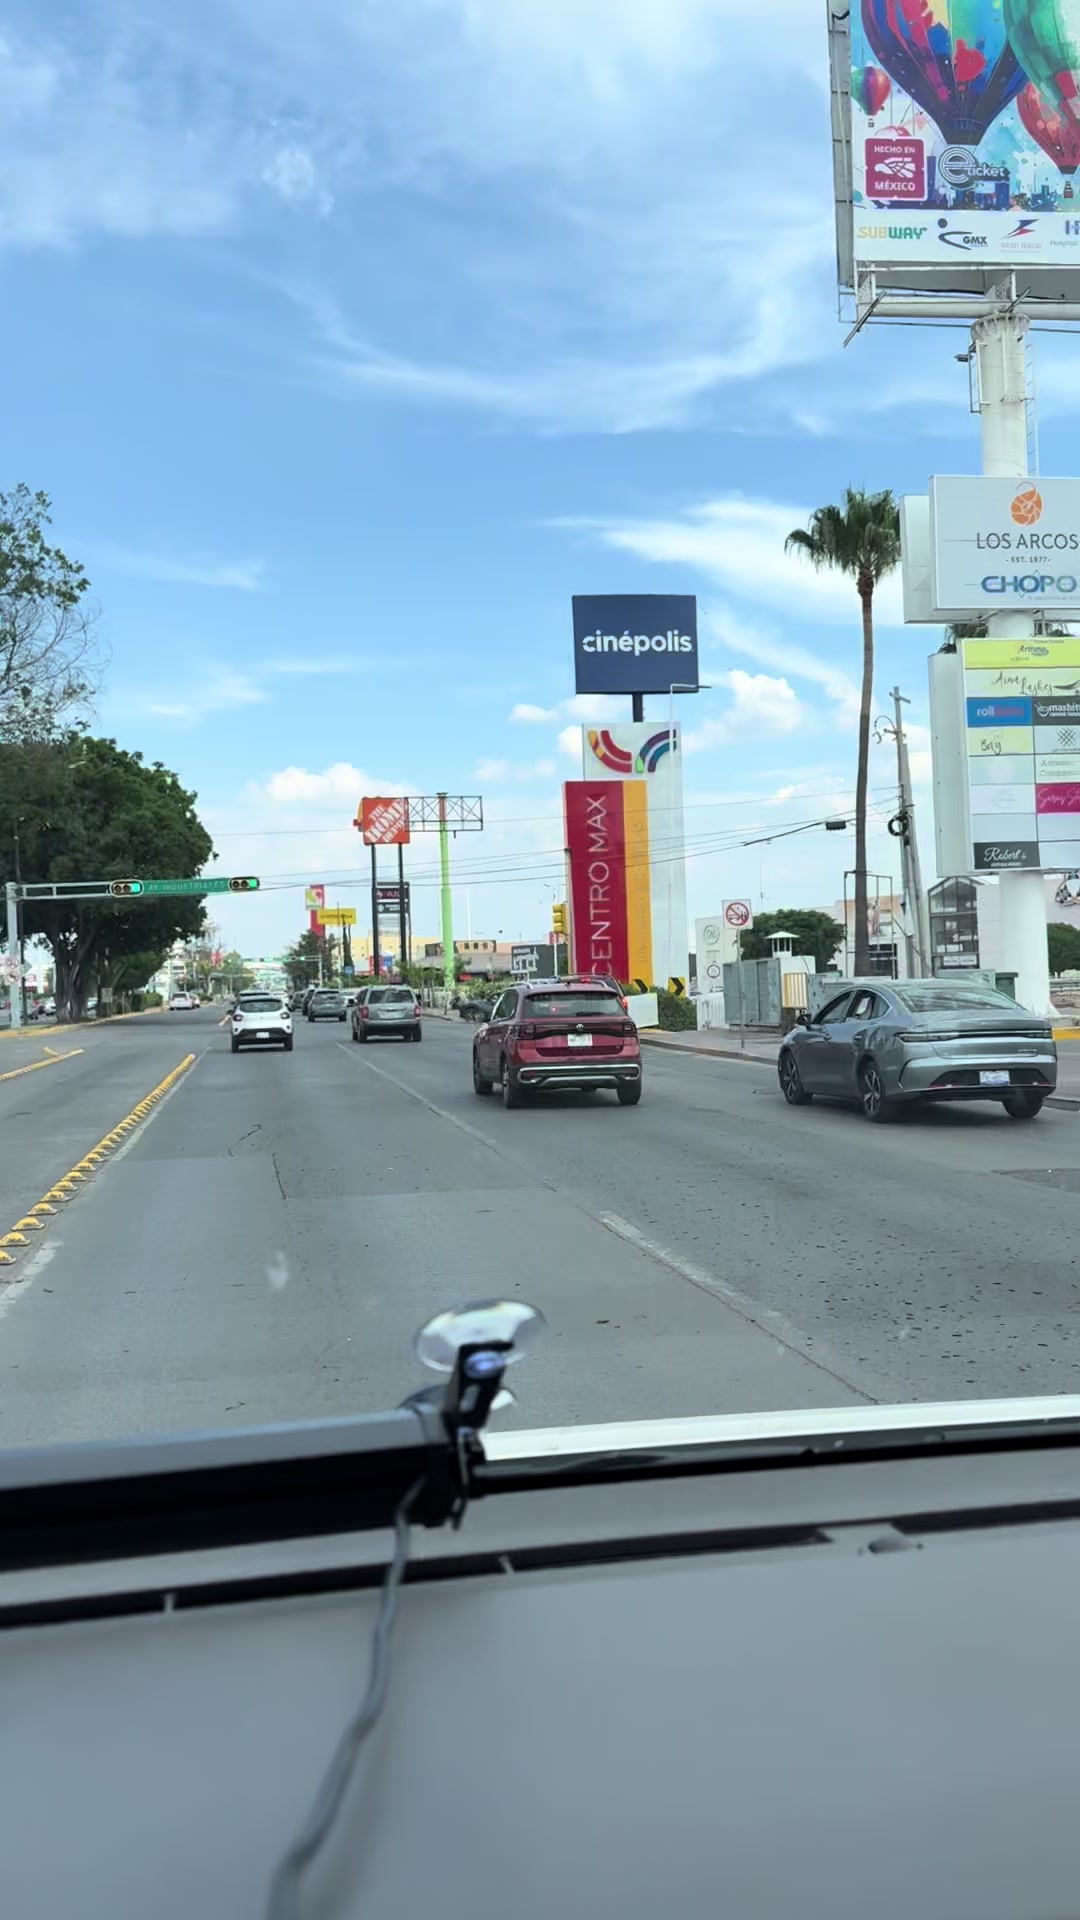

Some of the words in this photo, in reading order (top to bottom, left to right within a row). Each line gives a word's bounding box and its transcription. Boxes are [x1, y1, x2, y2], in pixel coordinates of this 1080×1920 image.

[875, 180, 915, 191] MÉXICO
[858, 226, 927, 240] SUBWAY
[963, 236, 988, 245] GMX
[976, 533, 1012, 549] LOS
[1016, 533, 1079, 550] ARCOS
[981, 575, 1078, 593] CHOPO
[582, 629, 693, 656] cinépolis
[586, 796, 608, 852] MAX
[588, 861, 613, 977] CENTRO
